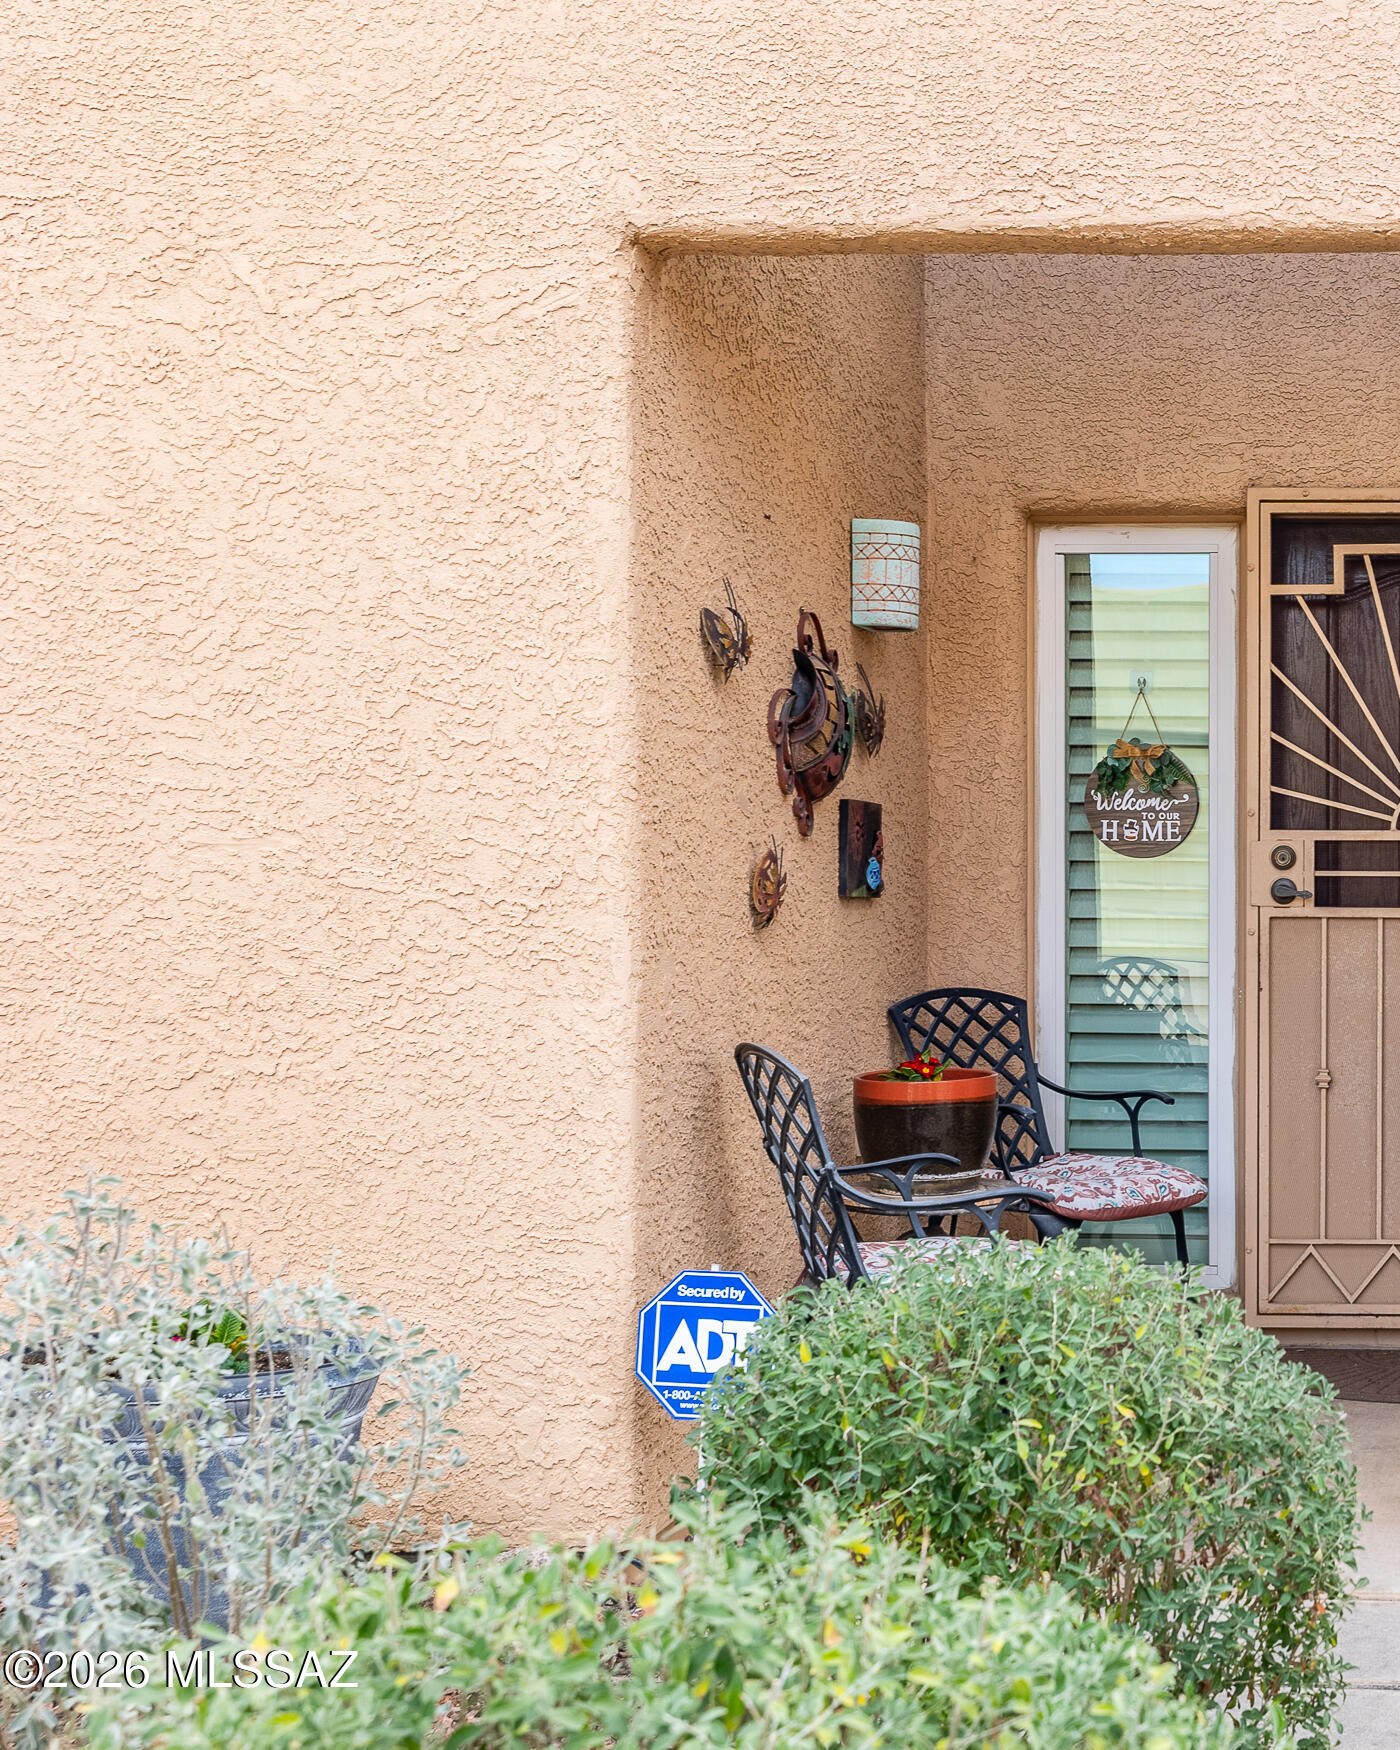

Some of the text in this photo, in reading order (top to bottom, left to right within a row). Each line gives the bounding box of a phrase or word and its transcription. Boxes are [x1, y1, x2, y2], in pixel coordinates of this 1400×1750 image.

[1090, 788, 1189, 811] Welcome
[1141, 812, 1180, 820] TO OUR
[677, 1284, 746, 1302] Secured by
[655, 1318, 759, 1374] ADT
